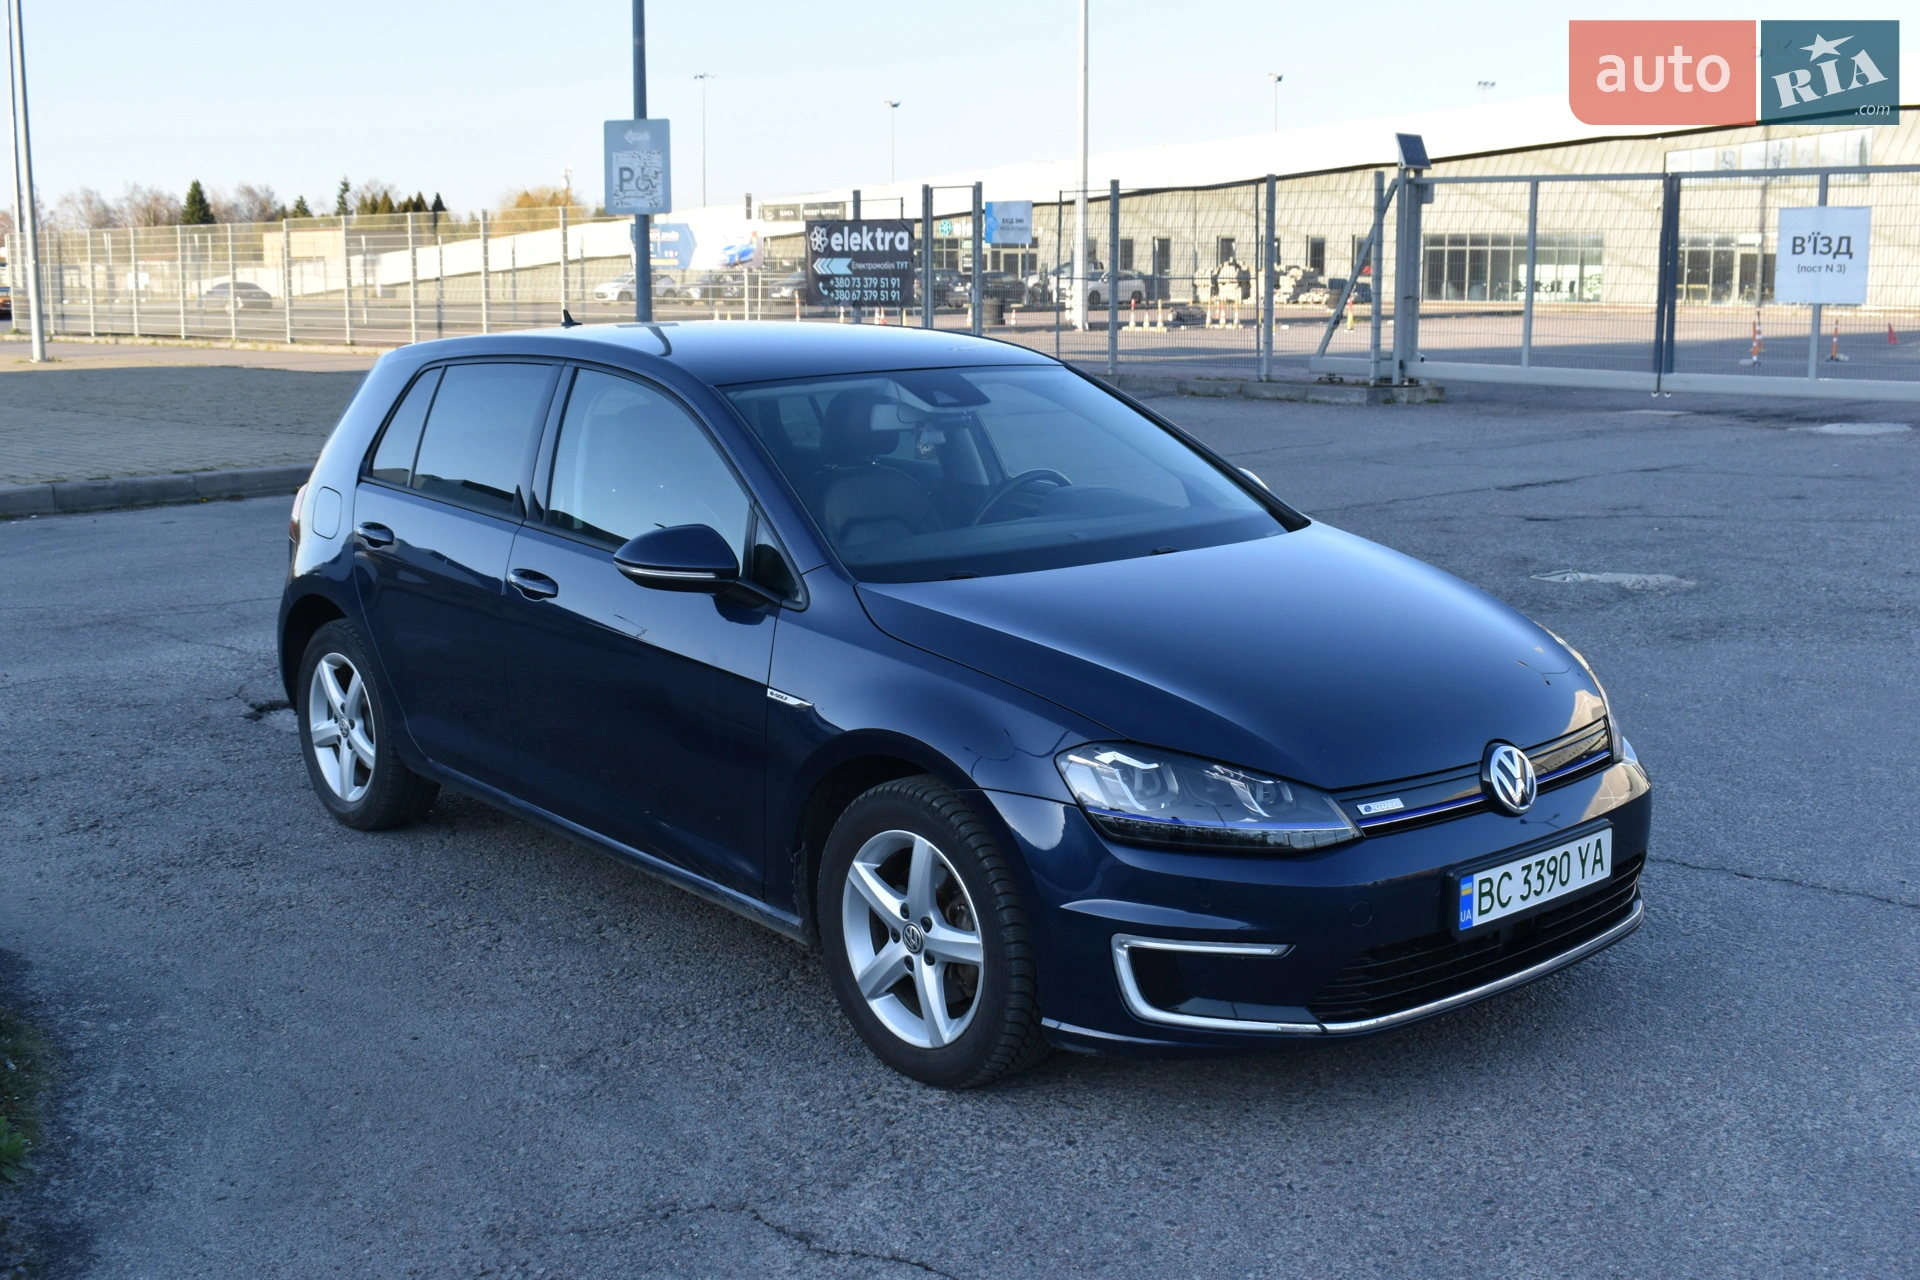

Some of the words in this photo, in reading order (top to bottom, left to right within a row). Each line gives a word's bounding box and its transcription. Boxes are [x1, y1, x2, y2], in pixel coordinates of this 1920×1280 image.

[619, 166, 635, 192] P
[830, 226, 909, 252] elektra
[1791, 231, 1853, 260] В'ЇЗД
[852, 261, 895, 271] Електромобілі
[896, 261, 908, 270] ТУТ
[1797, 263, 1822, 274] (пост
[1825, 264, 1834, 272] N
[1836, 263, 1846, 274] 3)
[830, 277, 850, 288] +380
[852, 277, 861, 288] 73
[863, 277, 878, 288] 379
[880, 277, 889, 288] 51
[890, 277, 900, 288] 91
[830, 289, 850, 300] +380
[852, 289, 861, 300] 67
[863, 289, 878, 300] 379
[880, 289, 889, 300] 51
[890, 289, 900, 300] 91
[1478, 871, 1513, 916] BC
[1519, 850, 1571, 901] 3390
[1577, 837, 1604, 880] YA
[1460, 909, 1472, 922] UA
